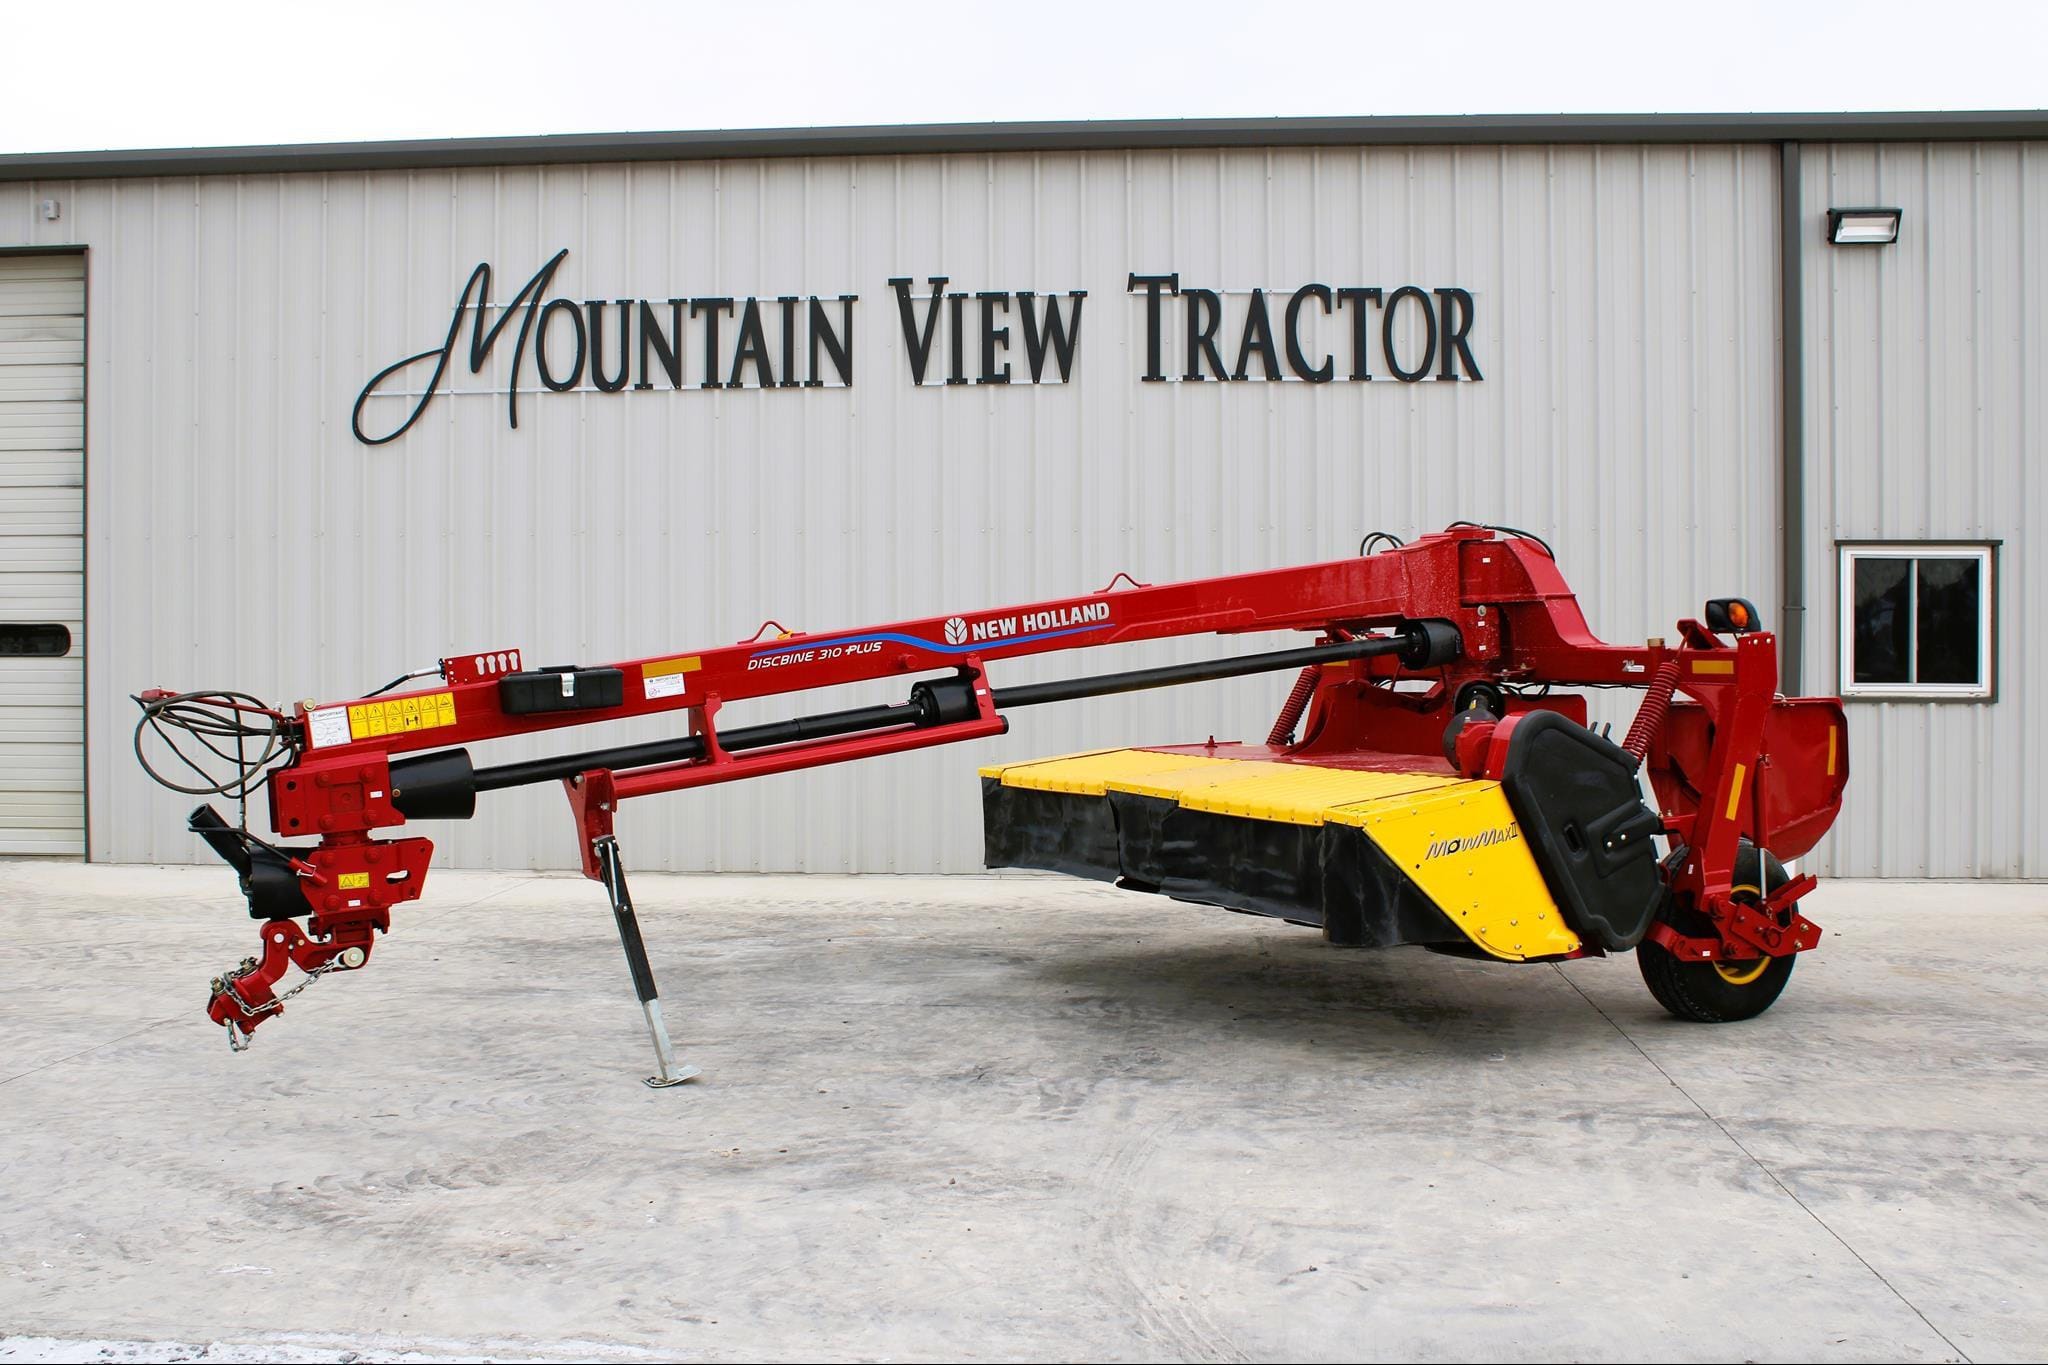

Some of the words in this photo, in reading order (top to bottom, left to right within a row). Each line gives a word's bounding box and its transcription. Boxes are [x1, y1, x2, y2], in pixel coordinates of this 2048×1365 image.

[352, 248, 859, 445] MOUNTAIN
[887, 276, 1088, 386] VIEW
[1127, 272, 1485, 384] TRACTOR
[971, 616, 1017, 641] NEW
[1022, 602, 1110, 633] HOLLAND
[747, 650, 815, 671] DISCBINE
[818, 647, 842, 661] 310
